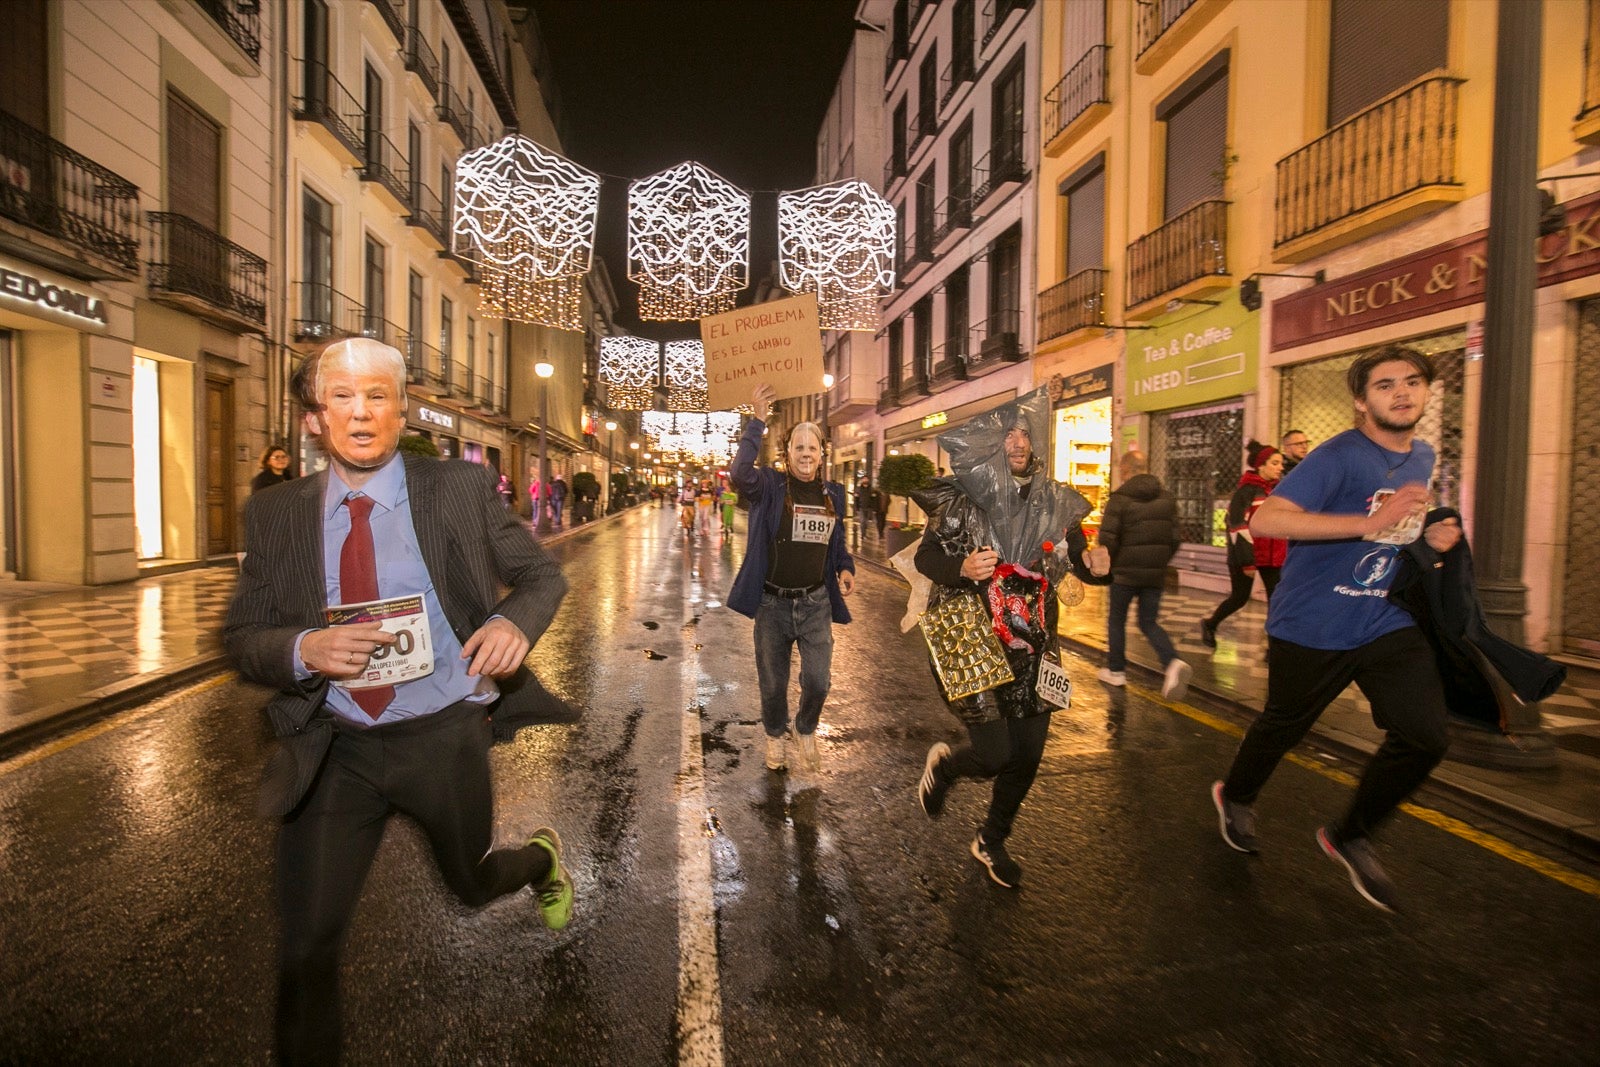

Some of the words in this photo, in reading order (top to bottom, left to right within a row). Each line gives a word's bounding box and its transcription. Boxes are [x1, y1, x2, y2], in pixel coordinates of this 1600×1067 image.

[1325, 272, 1417, 322] NECK
[1424, 262, 1457, 295] &
[735, 309, 805, 333] PROBLEMA
[712, 350, 728, 361] ES
[731, 346, 746, 356] EL
[752, 337, 791, 352] CAMBIO
[1143, 346, 1167, 363] Tea
[1169, 339, 1180, 356] &
[1183, 327, 1233, 352] Coffee
[1134, 380, 1139, 396] I
[1142, 370, 1181, 394] NEED
[800, 519, 831, 534] 1881
[1043, 669, 1070, 693] 1865
